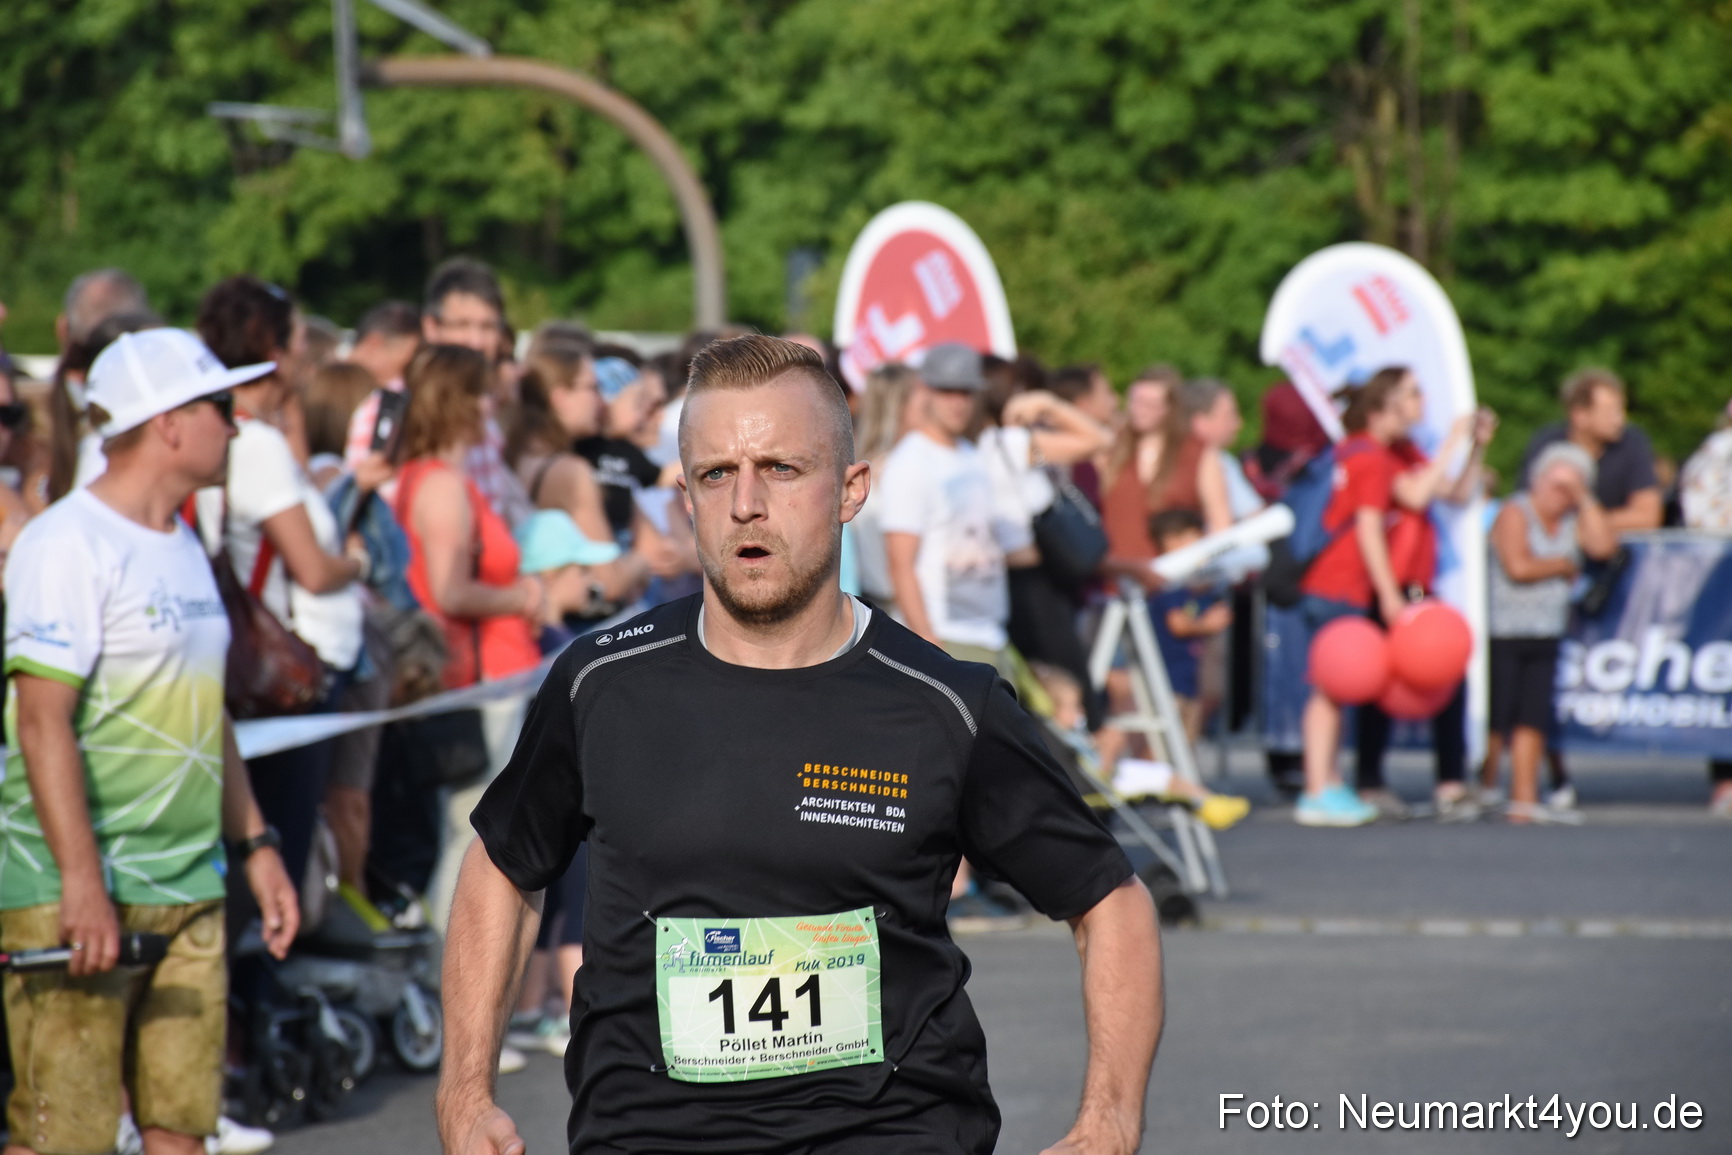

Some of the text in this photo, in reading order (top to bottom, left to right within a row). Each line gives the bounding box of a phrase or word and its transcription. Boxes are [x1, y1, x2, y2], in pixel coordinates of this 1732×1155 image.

[616, 624, 654, 640] JAKO
[804, 763, 908, 784] BERSCHNEIDER
[803, 778, 907, 799] BERSCHNEIDER
[800, 796, 906, 819] ARCHITEKTEN BDA
[800, 811, 905, 833] INNENARCHITEKTEN
[689, 949, 775, 967] firmenlauf
[826, 953, 866, 970] 2019
[708, 973, 823, 1035] 141
[674, 1055, 747, 1066] Berschneider
[759, 1046, 833, 1063] Berschneider
[835, 1038, 870, 1053] GmbH
[719, 1031, 824, 1053] Pöllet Martin
